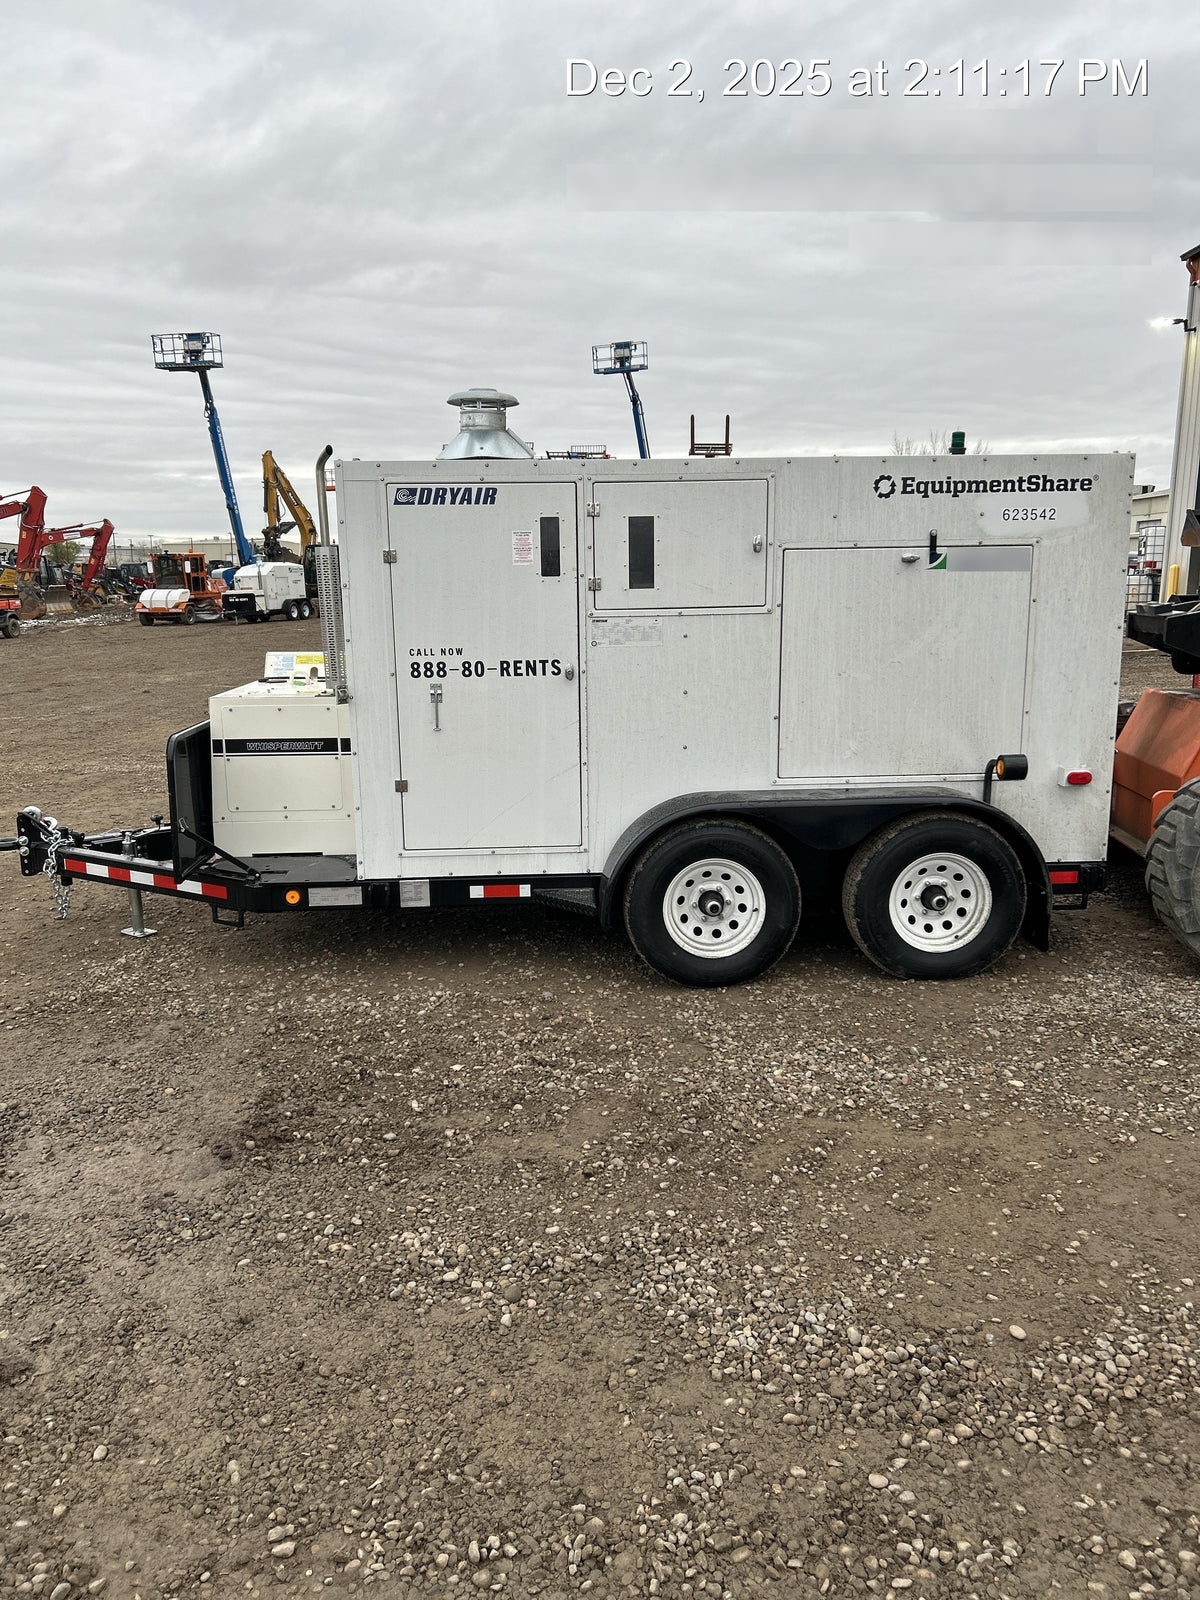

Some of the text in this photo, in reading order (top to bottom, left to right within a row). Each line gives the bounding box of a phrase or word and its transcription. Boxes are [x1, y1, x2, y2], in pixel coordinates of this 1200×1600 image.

[900, 474, 1093, 498] EquipmentShare
[417, 487, 498, 506] DRYAIR
[1002, 508, 1057, 521] 623542
[409, 647, 464, 656] CALL NOW
[246, 741, 324, 751] WHISPERWATT
